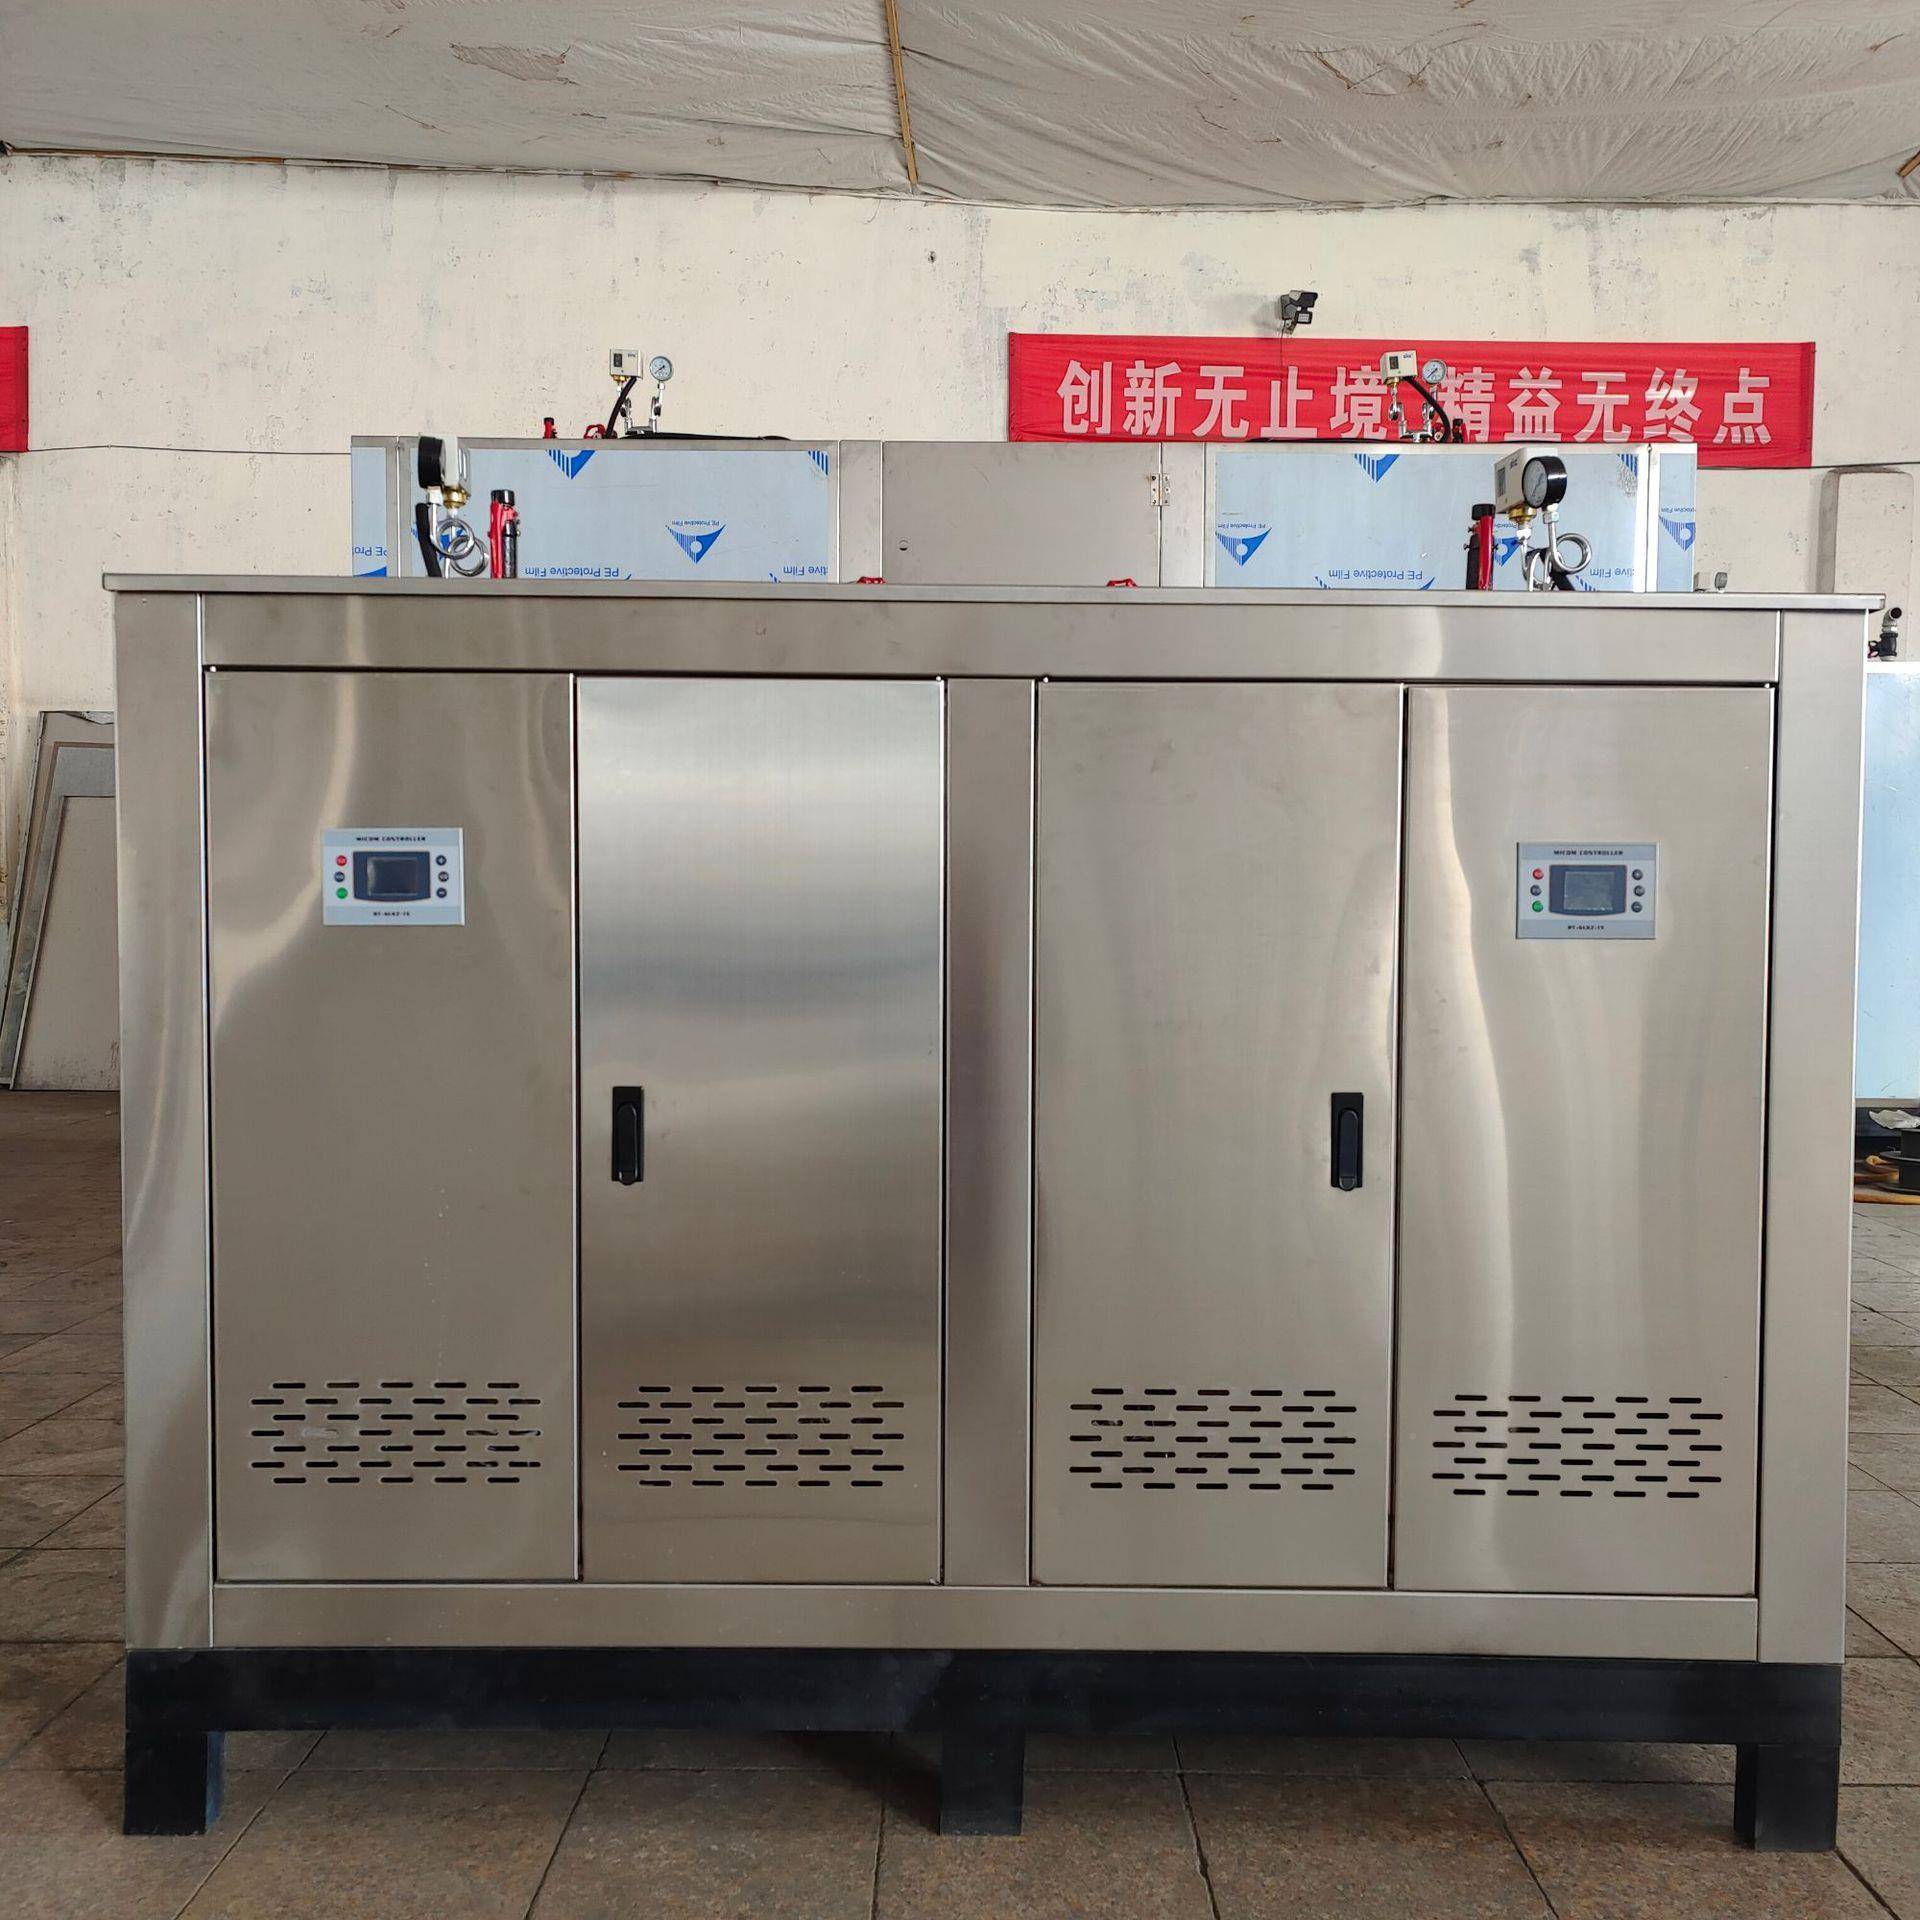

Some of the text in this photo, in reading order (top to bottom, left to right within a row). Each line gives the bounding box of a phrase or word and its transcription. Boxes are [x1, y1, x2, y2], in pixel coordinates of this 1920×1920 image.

[1056, 359, 1772, 445] 创新无止境 精益无终点
[525, 567, 619, 577] PE Protective Film
[783, 566, 805, 576] Film
[1329, 569, 1423, 580] PE Protective Film
[1590, 568, 1612, 578] Film
